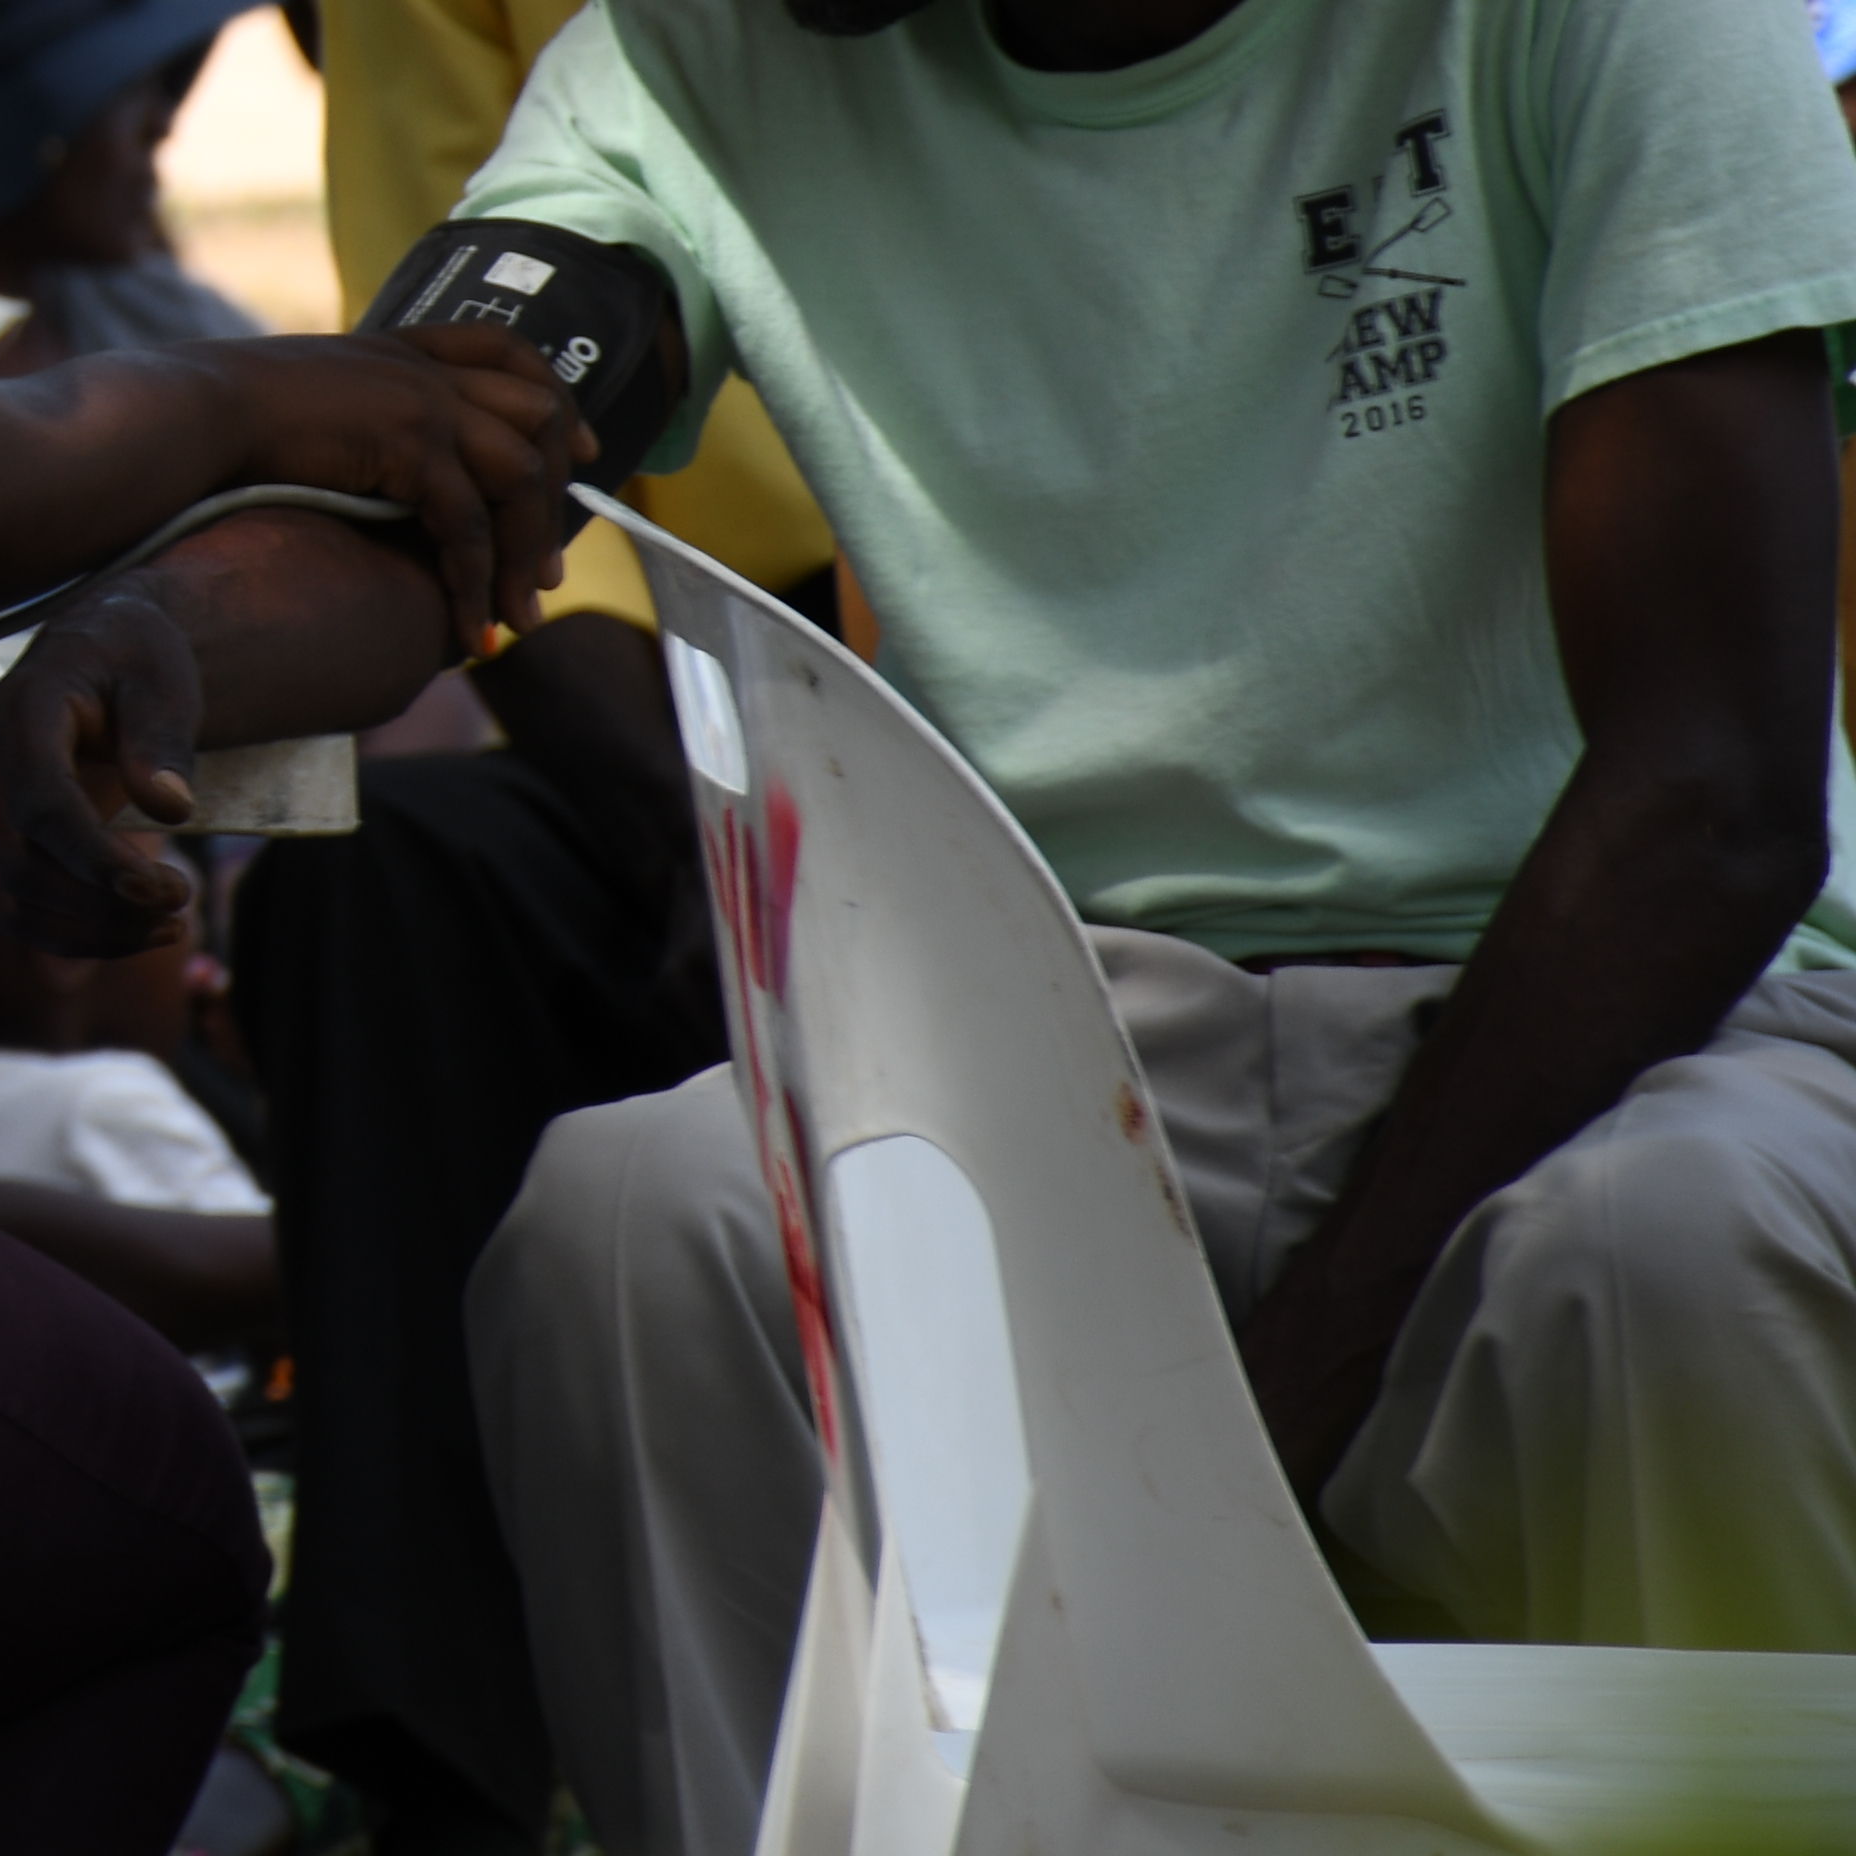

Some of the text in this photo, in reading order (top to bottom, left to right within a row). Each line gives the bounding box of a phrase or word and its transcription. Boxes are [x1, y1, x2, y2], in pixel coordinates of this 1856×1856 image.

[1295, 109, 1450, 274] ET
[1333, 290, 1442, 356] EW
[1333, 338, 1446, 406] AMP
[1341, 396, 1425, 437] 2016
